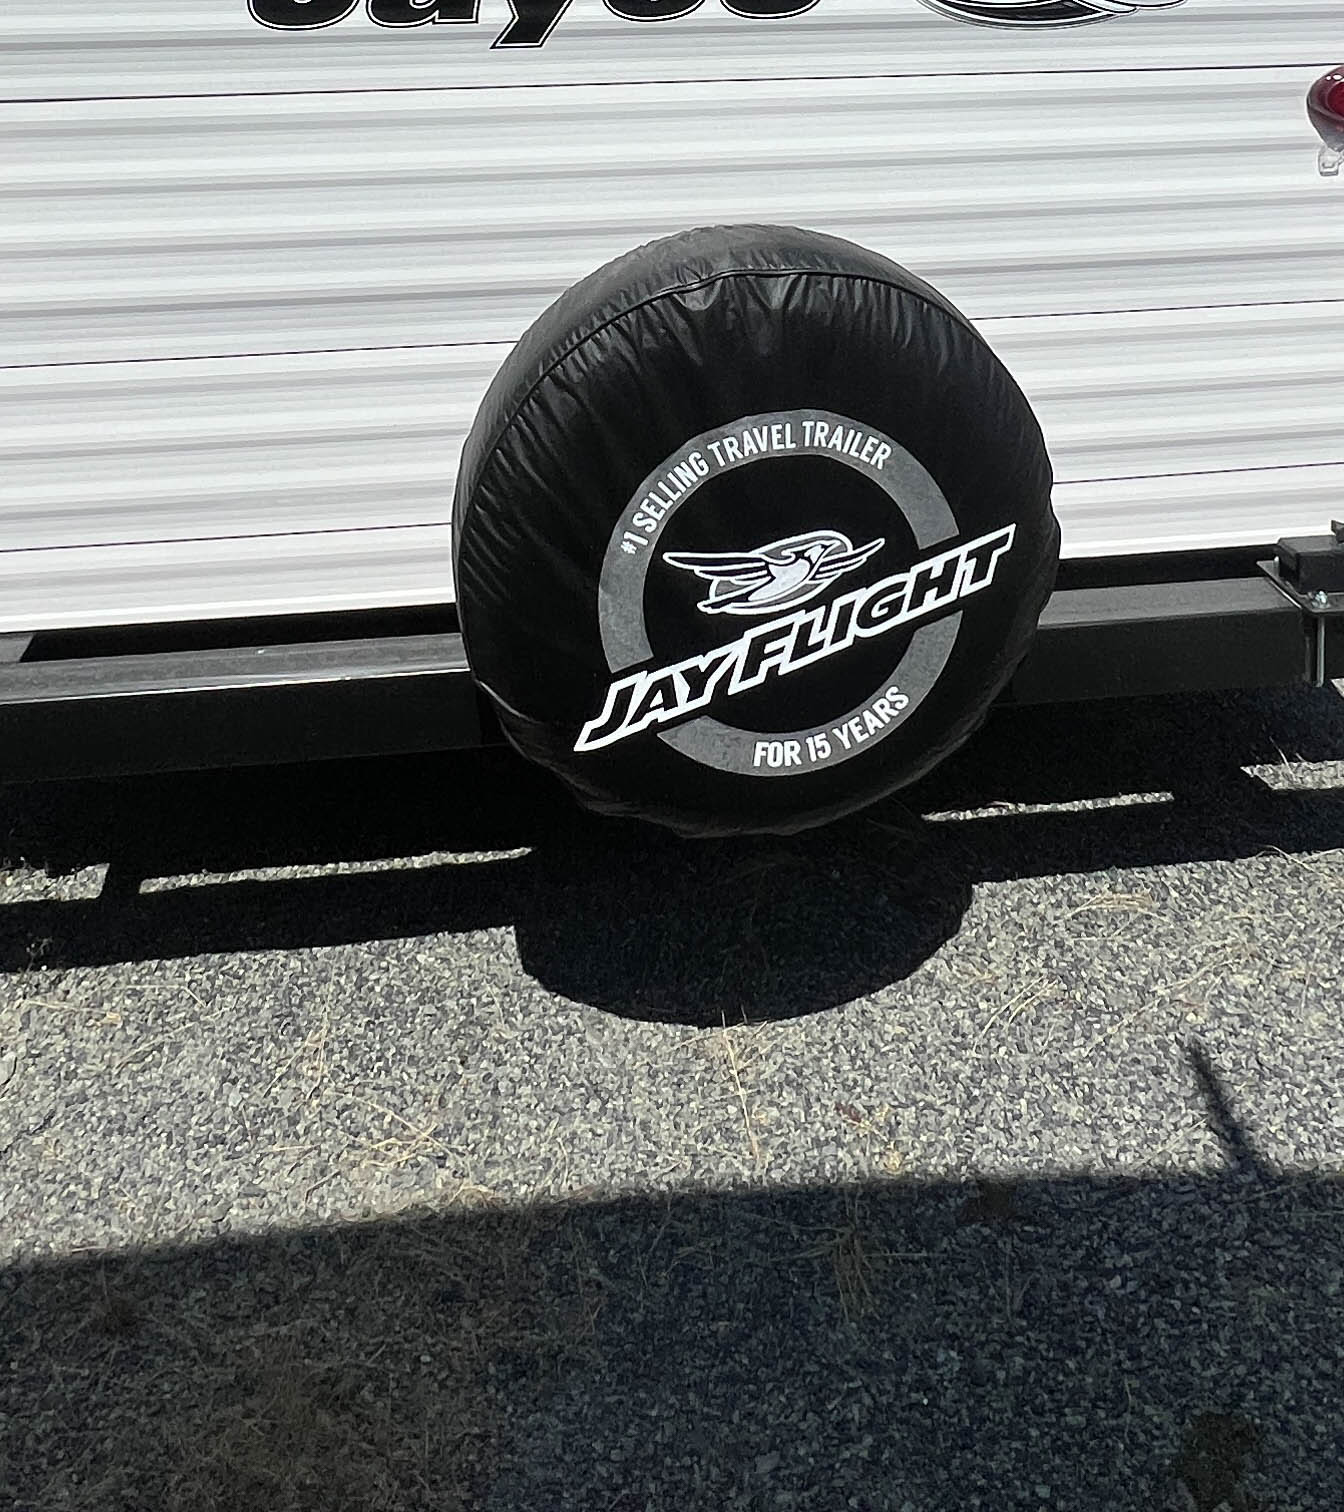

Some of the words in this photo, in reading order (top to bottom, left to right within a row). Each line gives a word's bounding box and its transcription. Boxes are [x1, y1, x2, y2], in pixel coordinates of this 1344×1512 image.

[707, 422, 796, 467] TRAVEL
[801, 420, 892, 470] TRAILER
[632, 451, 709, 533] SELLING
[620, 529, 649, 555] #1
[752, 740, 802, 768] FOR
[805, 735, 832, 762] 15
[836, 686, 910, 749] YEARS
